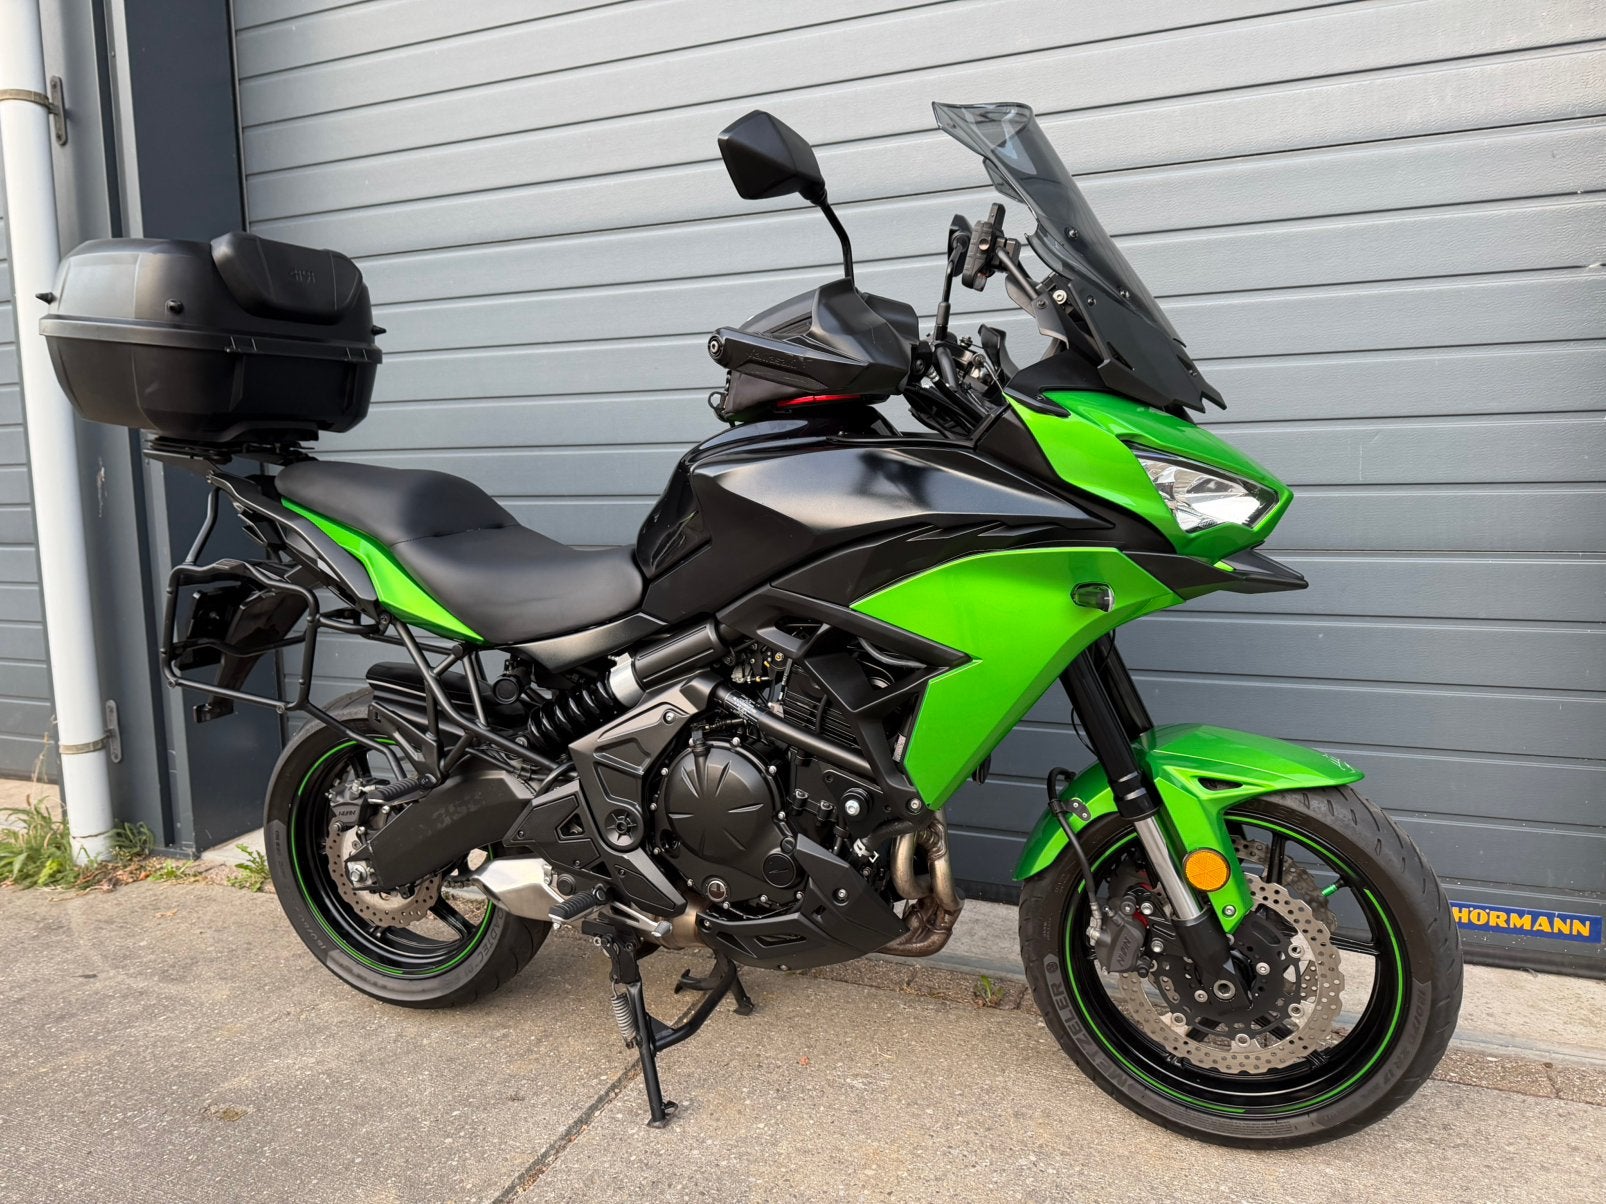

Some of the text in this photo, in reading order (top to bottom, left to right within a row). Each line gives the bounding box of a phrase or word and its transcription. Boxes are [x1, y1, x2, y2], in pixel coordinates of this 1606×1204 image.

[477, 908, 504, 963] OADTEC
[1452, 907, 1591, 937] HÖRMANN
[1049, 982, 1130, 1088] METZELER
